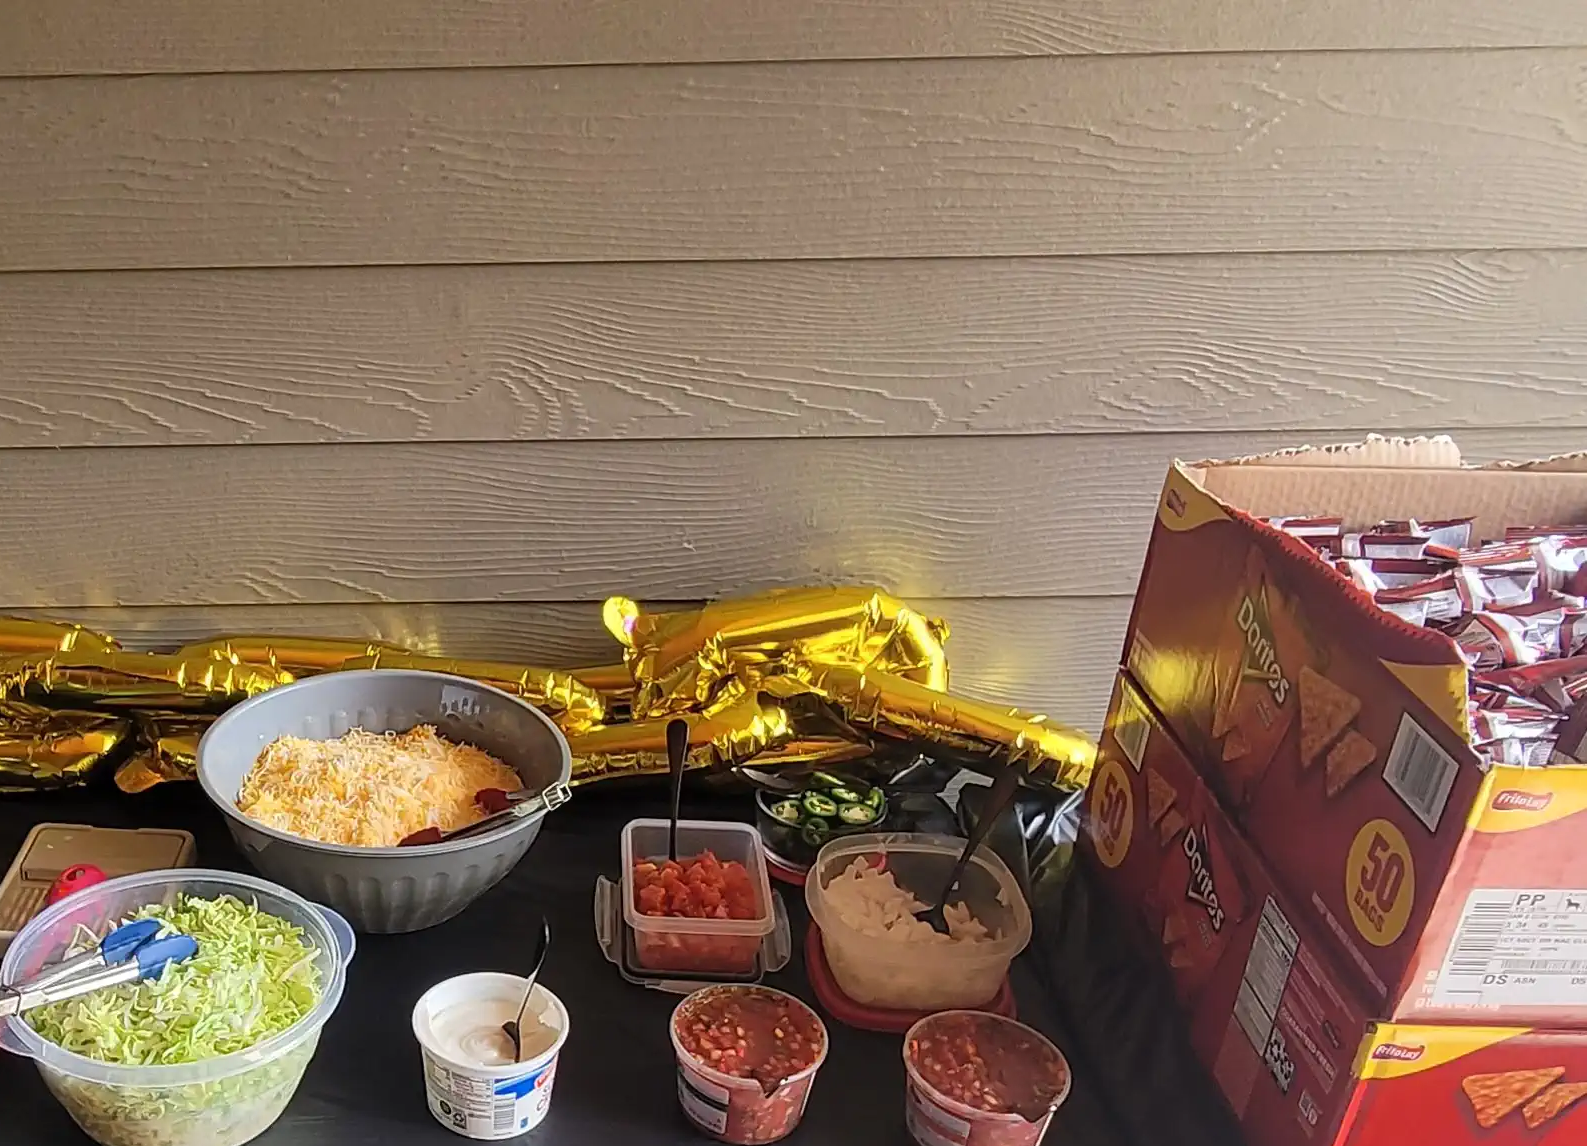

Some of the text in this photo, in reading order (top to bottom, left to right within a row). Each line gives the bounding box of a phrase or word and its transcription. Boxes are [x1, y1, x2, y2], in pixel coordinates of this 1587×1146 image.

[1237, 595, 1289, 704] Doritos
[1183, 827, 1226, 931] Doritos
[1360, 831, 1405, 913] 50
[1516, 894, 1545, 906] PP
[1354, 884, 1385, 933] BAGS
[1483, 974, 1508, 985] DS
